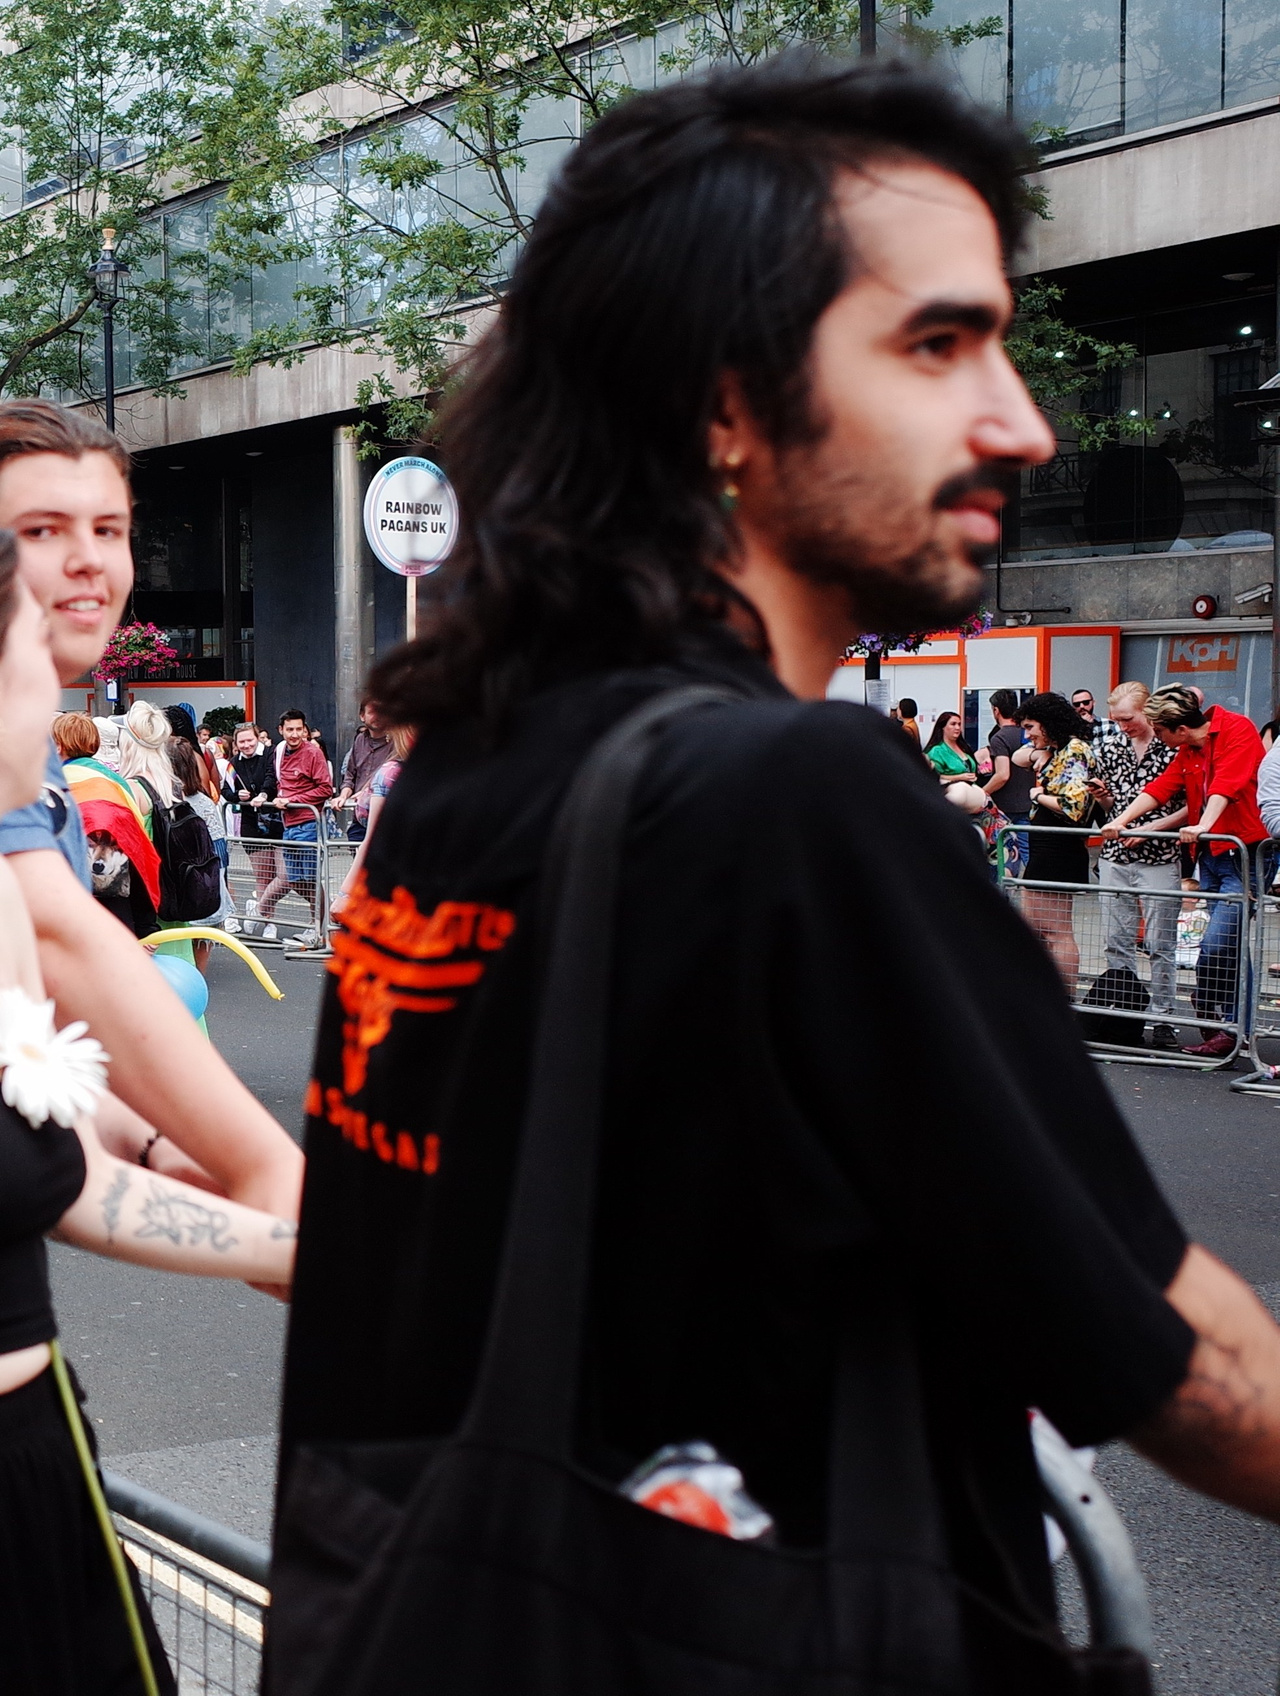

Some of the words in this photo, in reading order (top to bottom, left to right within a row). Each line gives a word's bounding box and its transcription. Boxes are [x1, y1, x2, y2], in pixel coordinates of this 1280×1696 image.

[385, 462, 404, 476] NEVER
[404, 460, 425, 468] MARCH
[385, 501, 442, 516] RAINBOW
[380, 519, 428, 533] PAGANS
[431, 521, 447, 535] UK
[176, 664, 197, 679] HOUSE
